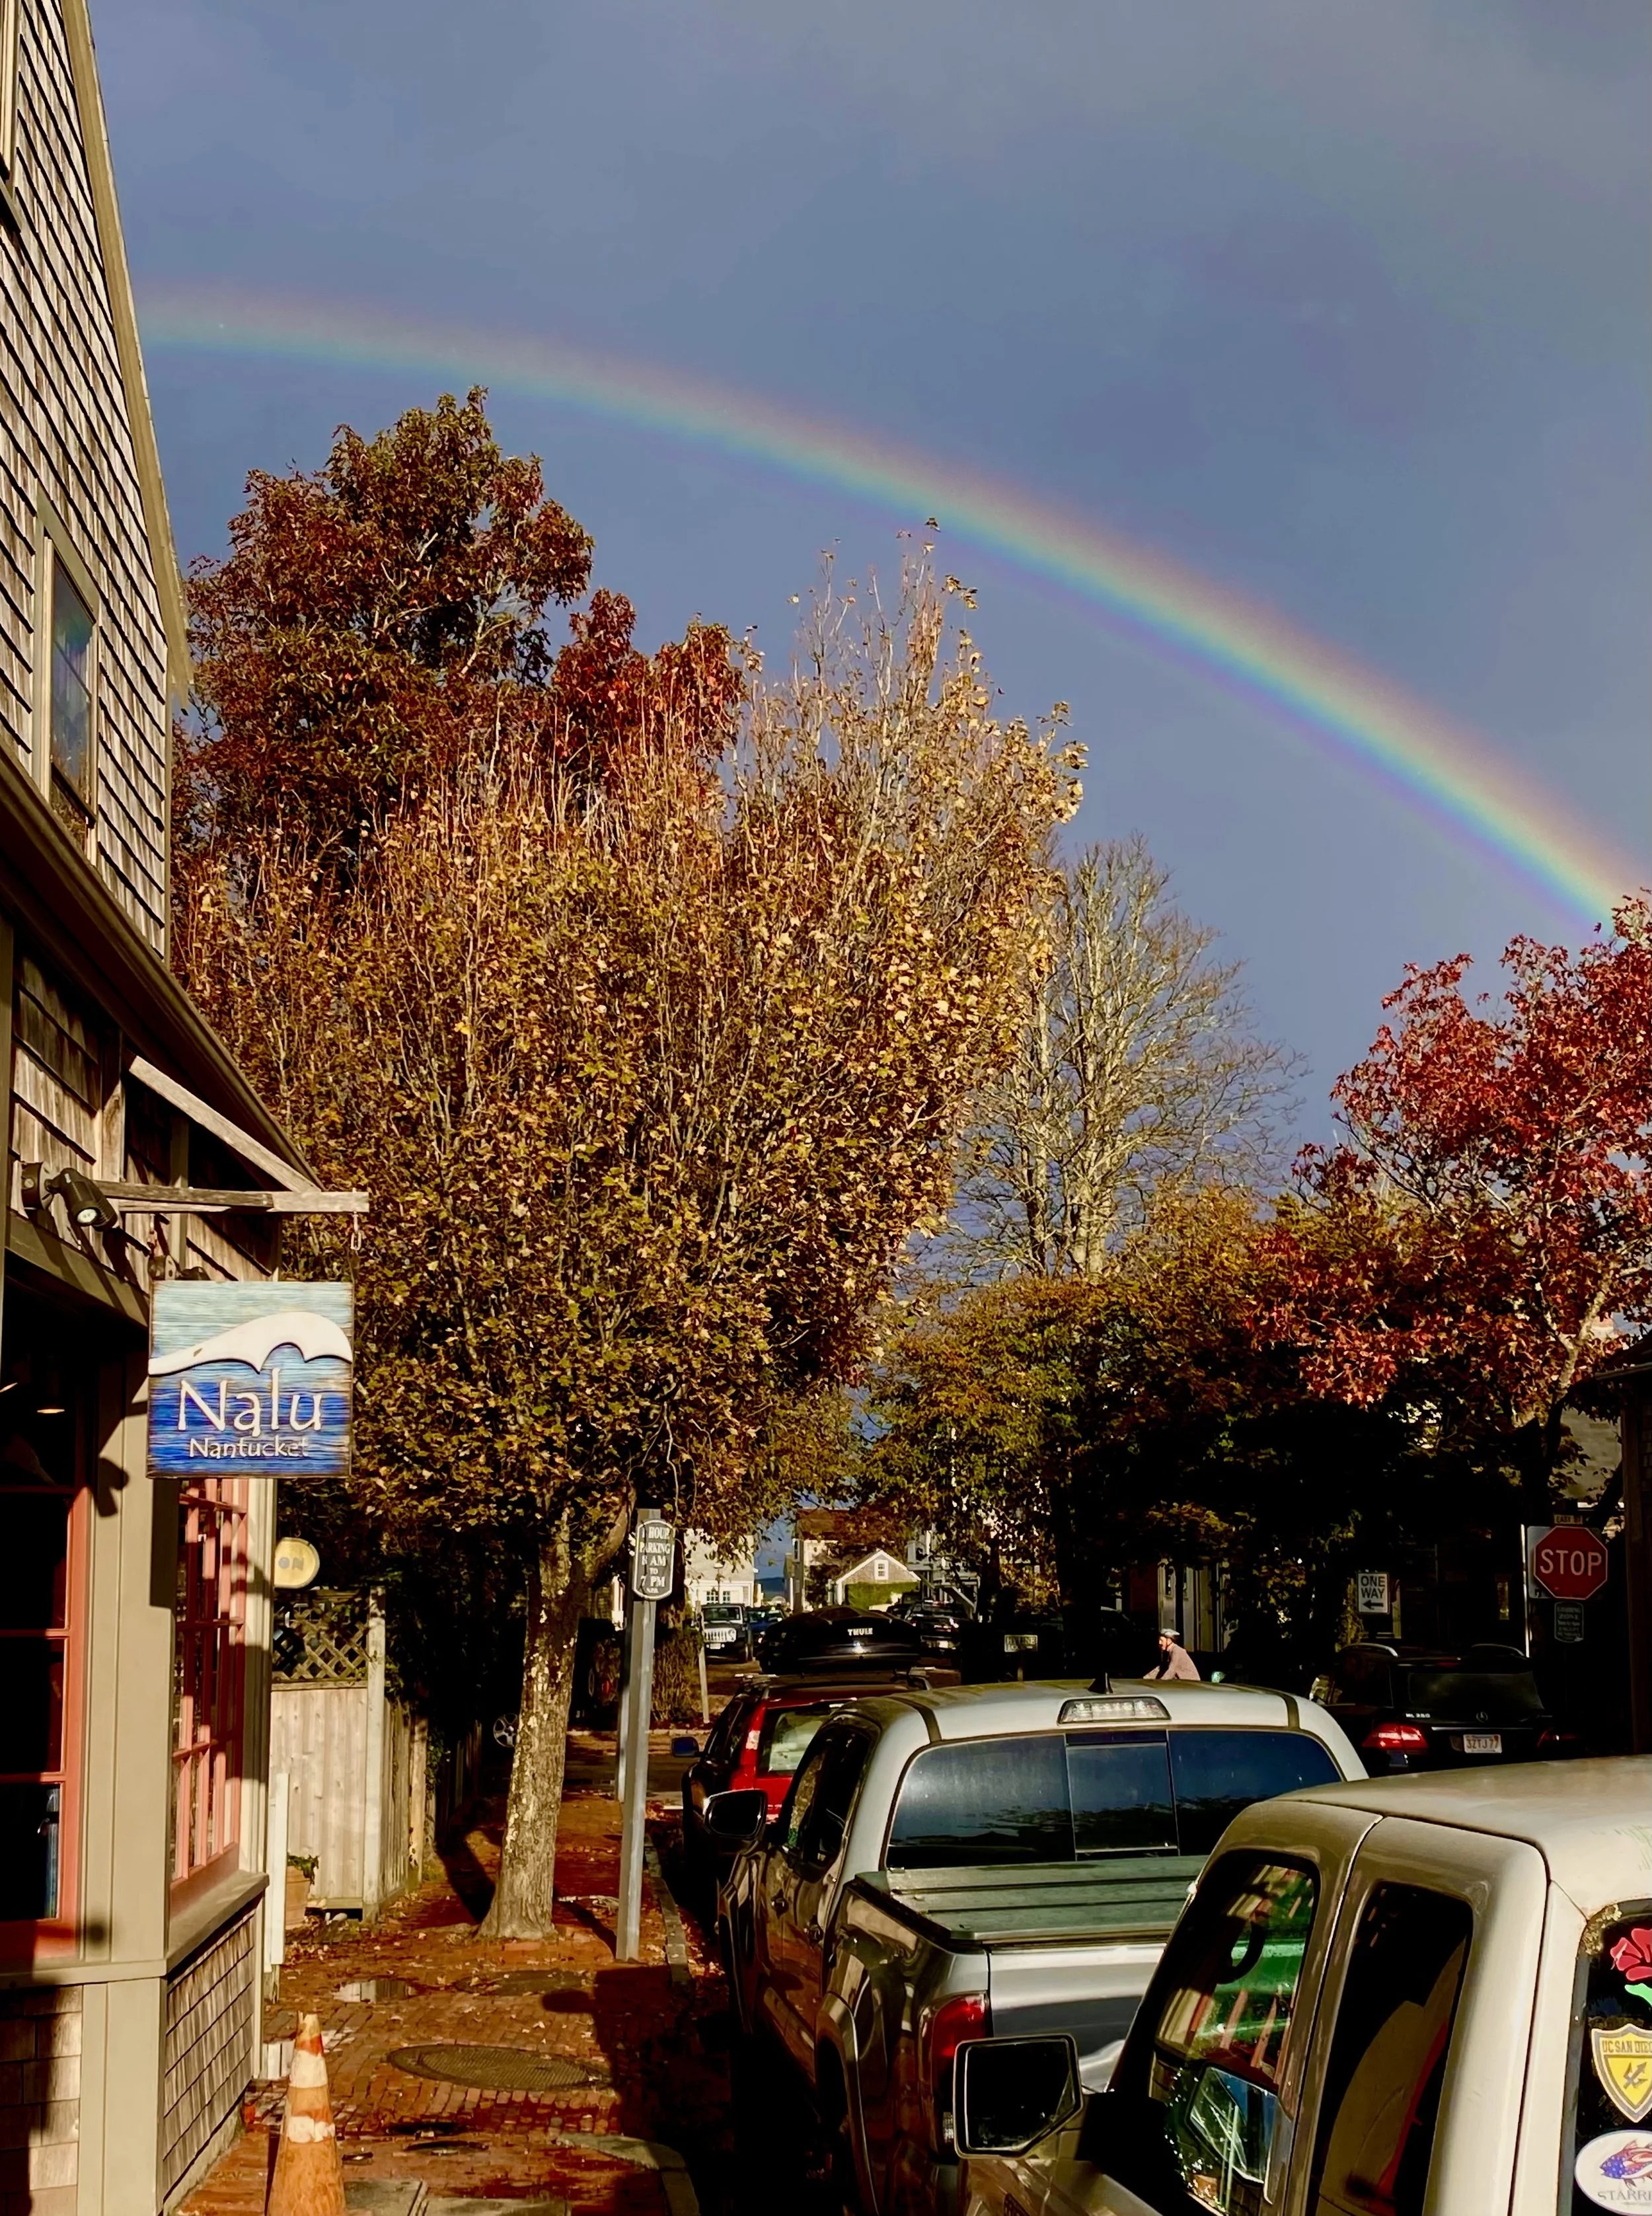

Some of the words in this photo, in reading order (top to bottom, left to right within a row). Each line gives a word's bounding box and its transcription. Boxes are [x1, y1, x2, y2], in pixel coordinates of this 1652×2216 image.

[178, 1368, 322, 1437] Nalu
[189, 1435, 309, 1459] Nantucket
[648, 1526, 670, 1539] HOUR
[640, 1541, 670, 1554] PARKING
[650, 1555, 666, 1567] AM
[1540, 1549, 1602, 1576] STOP
[650, 1576, 665, 1587] PM
[1361, 1576, 1386, 1587] ONE
[1361, 1588, 1385, 1598] WAY
[847, 1627, 873, 1636] THULE
[1602, 2040, 1614, 2053] UC
[1614, 2040, 1633, 2053] SAN
